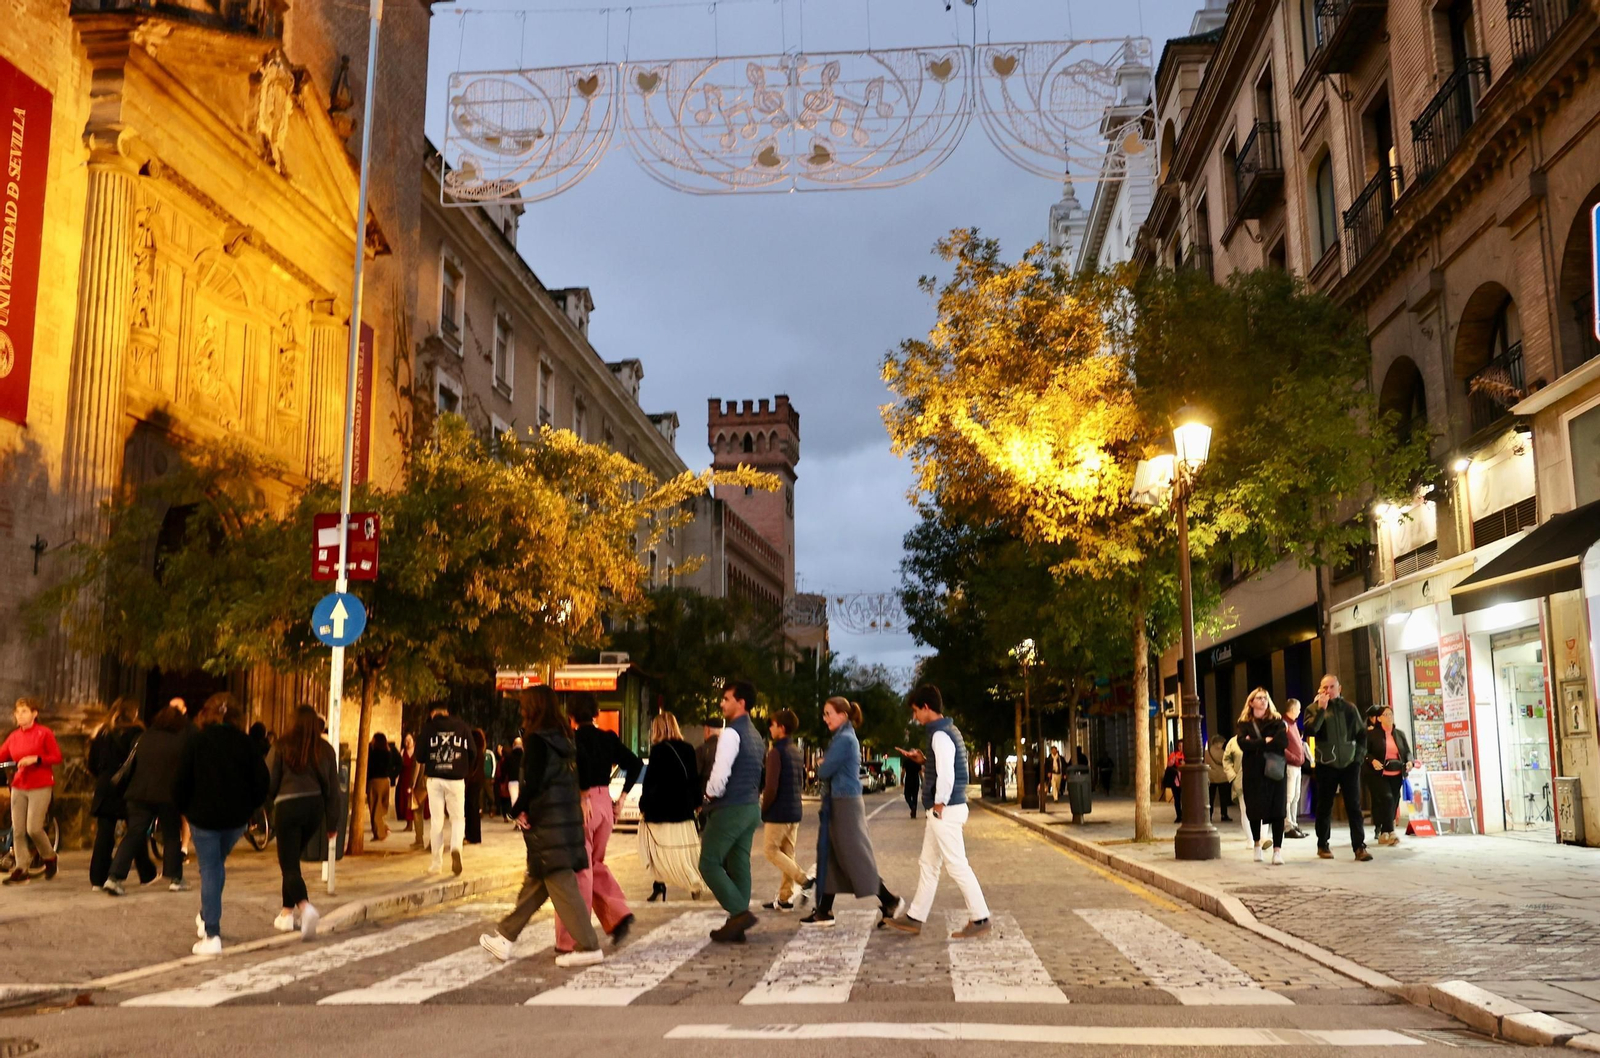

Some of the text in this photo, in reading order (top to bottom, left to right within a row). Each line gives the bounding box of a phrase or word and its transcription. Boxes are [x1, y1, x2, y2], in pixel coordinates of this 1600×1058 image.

[8, 107, 26, 181] SEVILLA
[0, 200, 18, 326] UNIVERSIDAD
[1415, 659, 1439, 667] Diseñ
